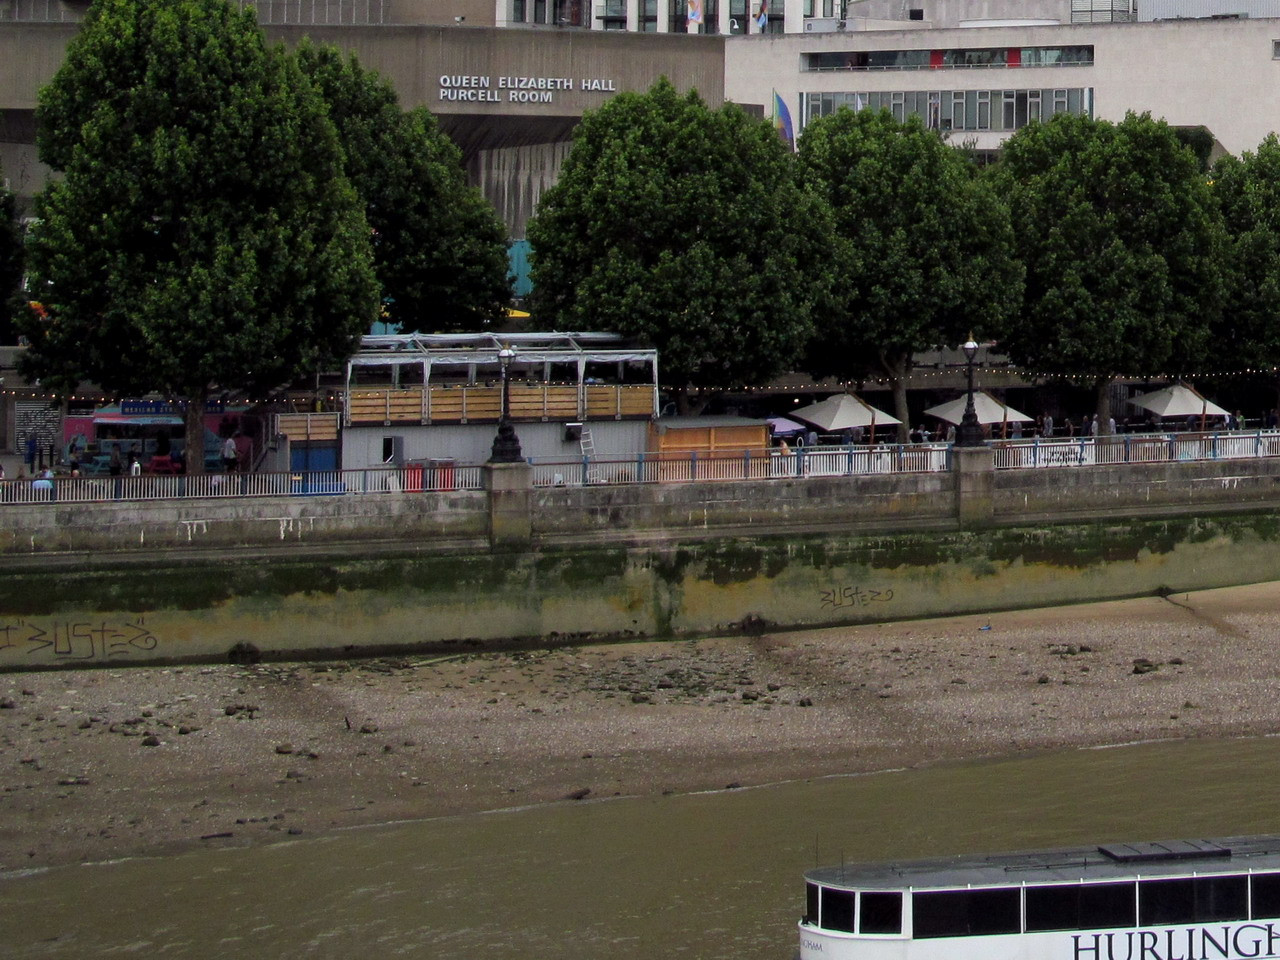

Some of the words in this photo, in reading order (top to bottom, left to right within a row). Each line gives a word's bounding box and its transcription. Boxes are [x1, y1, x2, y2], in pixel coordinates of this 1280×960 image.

[440, 75, 490, 88] QUEEN
[498, 77, 573, 90] ELIZABETH
[582, 79, 615, 91] HALL
[440, 89, 501, 102] PURCELL
[509, 91, 553, 103] ROOM
